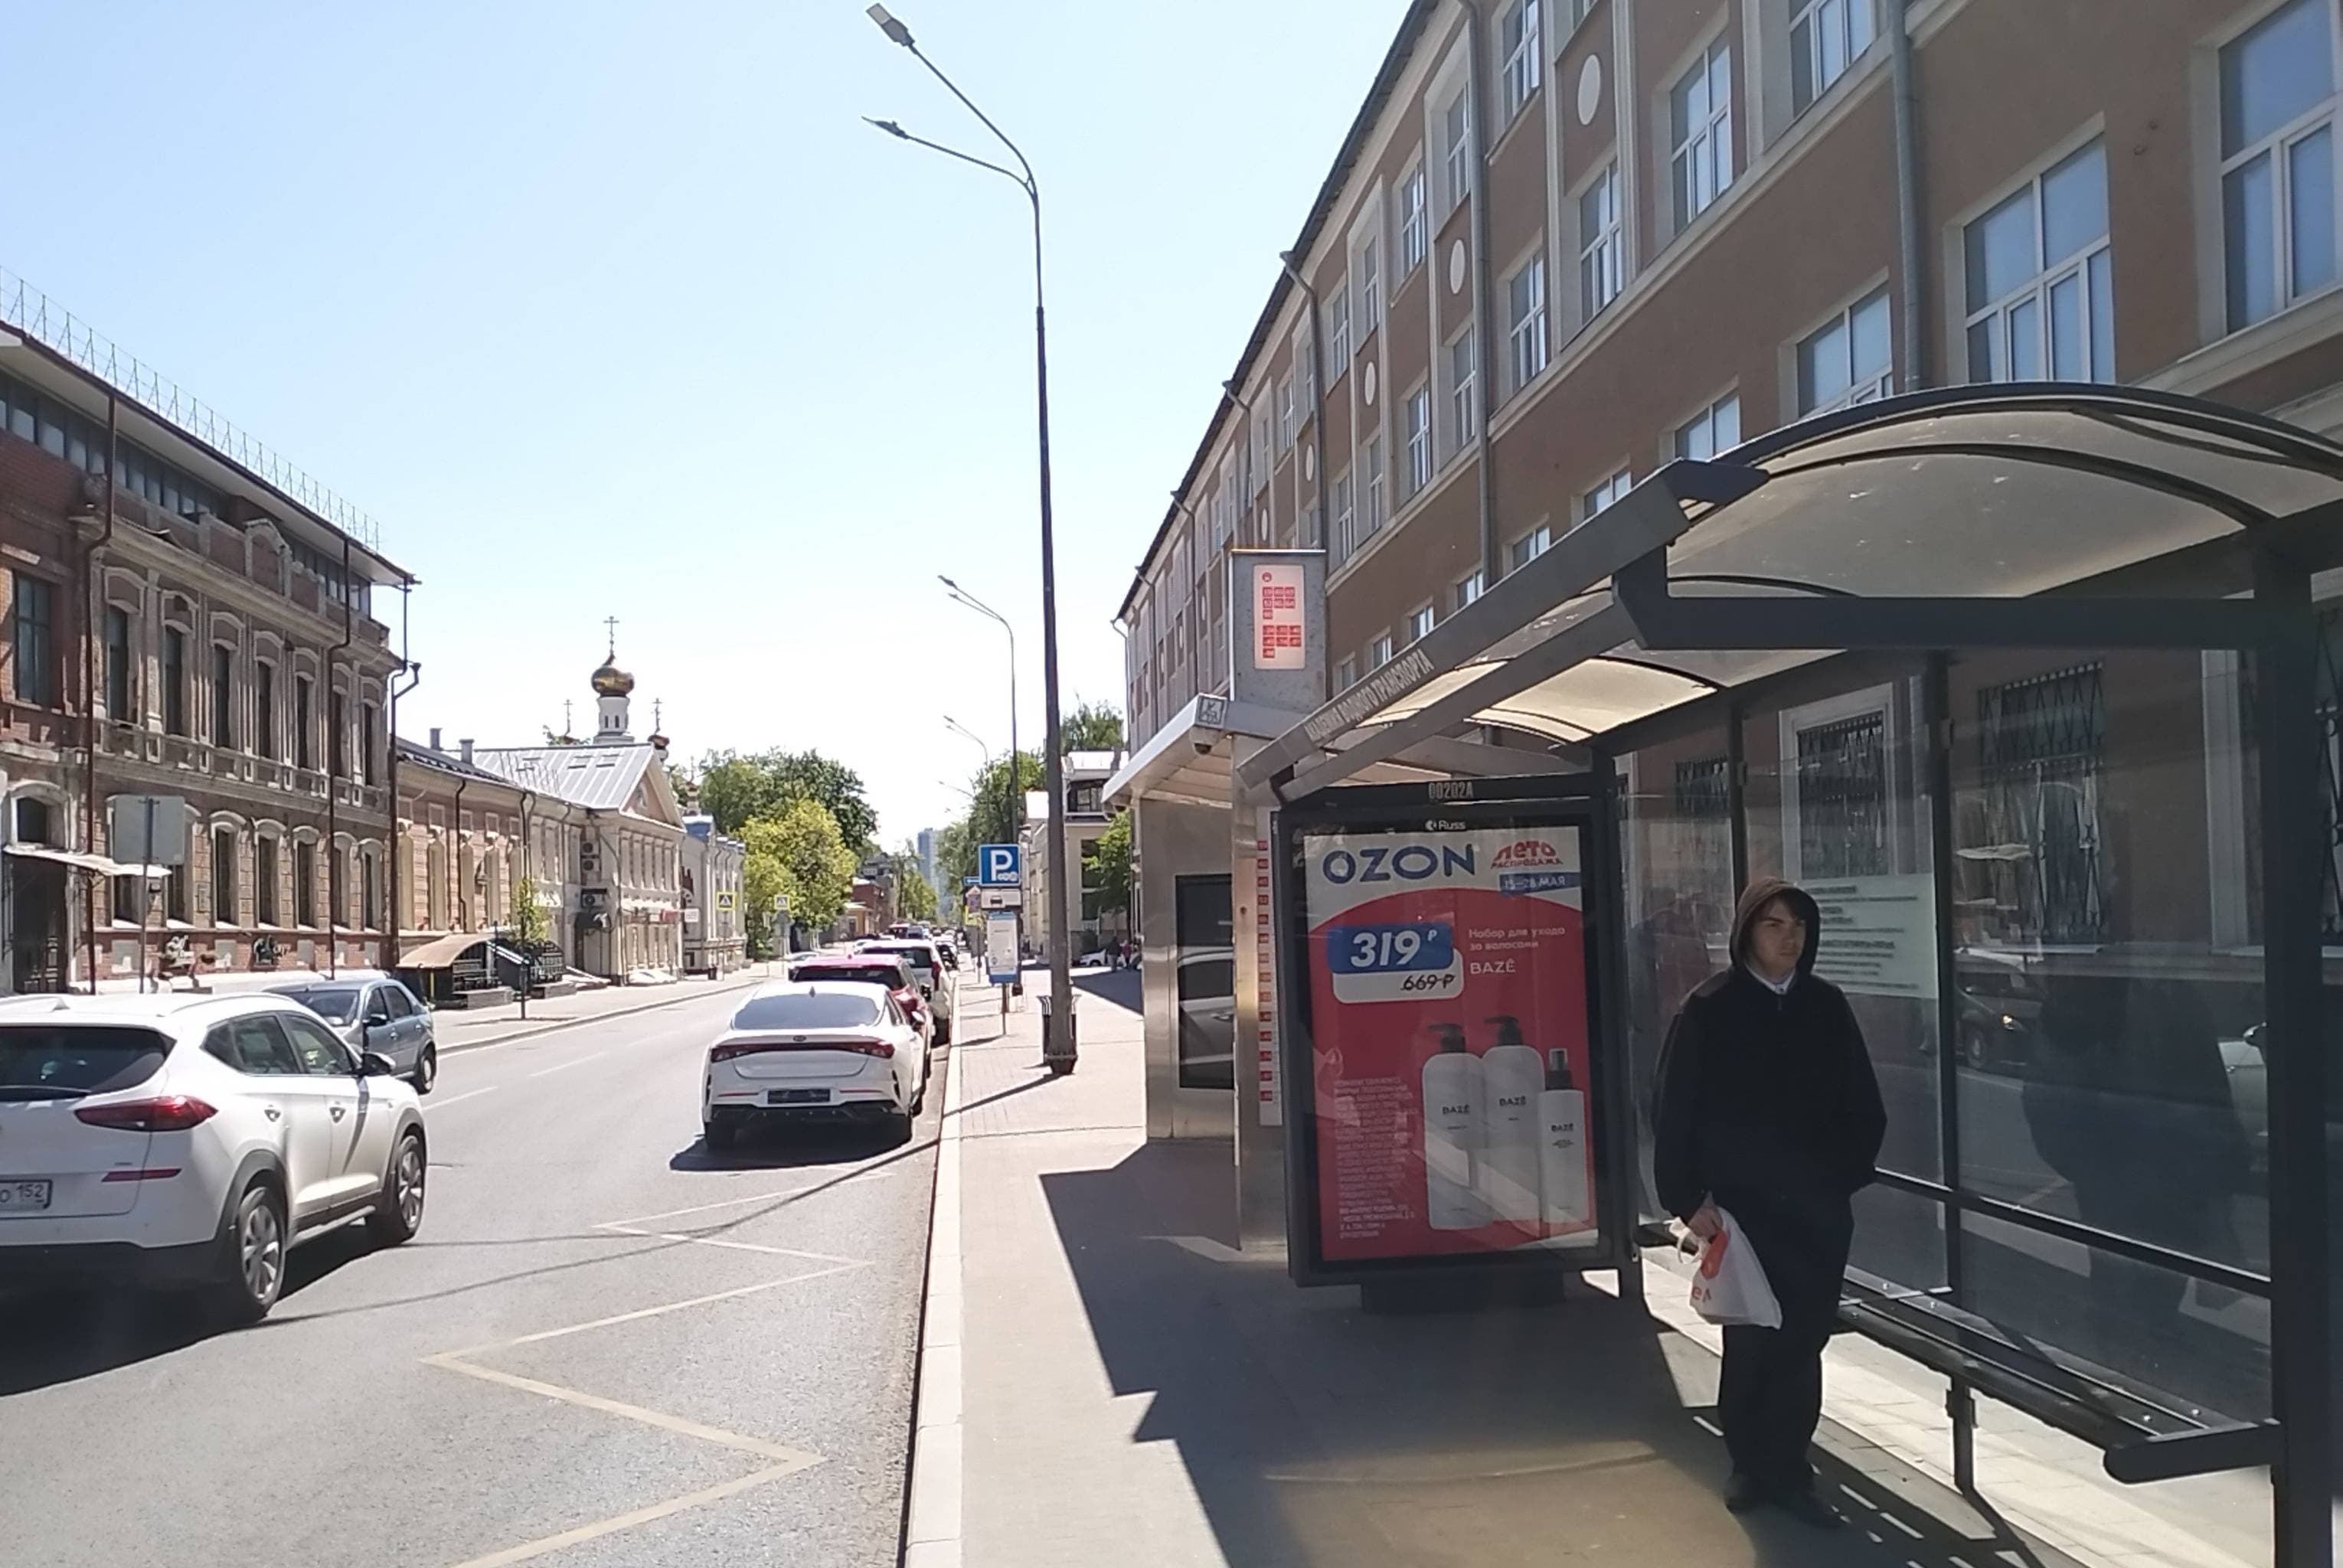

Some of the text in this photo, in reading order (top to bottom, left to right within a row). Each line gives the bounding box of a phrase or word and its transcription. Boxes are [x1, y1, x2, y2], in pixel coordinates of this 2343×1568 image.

[1337, 685, 1379, 722] ВОДНОГО
[1371, 648, 1435, 702] ТРАНСПОРТА
[1438, 820, 1466, 831] Russ
[990, 850, 1013, 881] P
[1323, 843, 1475, 884] OZON
[1490, 858, 1564, 870] РАСПРОДАЖА
[1539, 875, 1566, 887] МАЯ
[1469, 927, 1566, 939] Набор для ухода
[1351, 929, 1421, 967] 319
[1470, 942, 1483, 951] за
[1403, 974, 1438, 991] 669
[16, 1184, 44, 1197] 152
